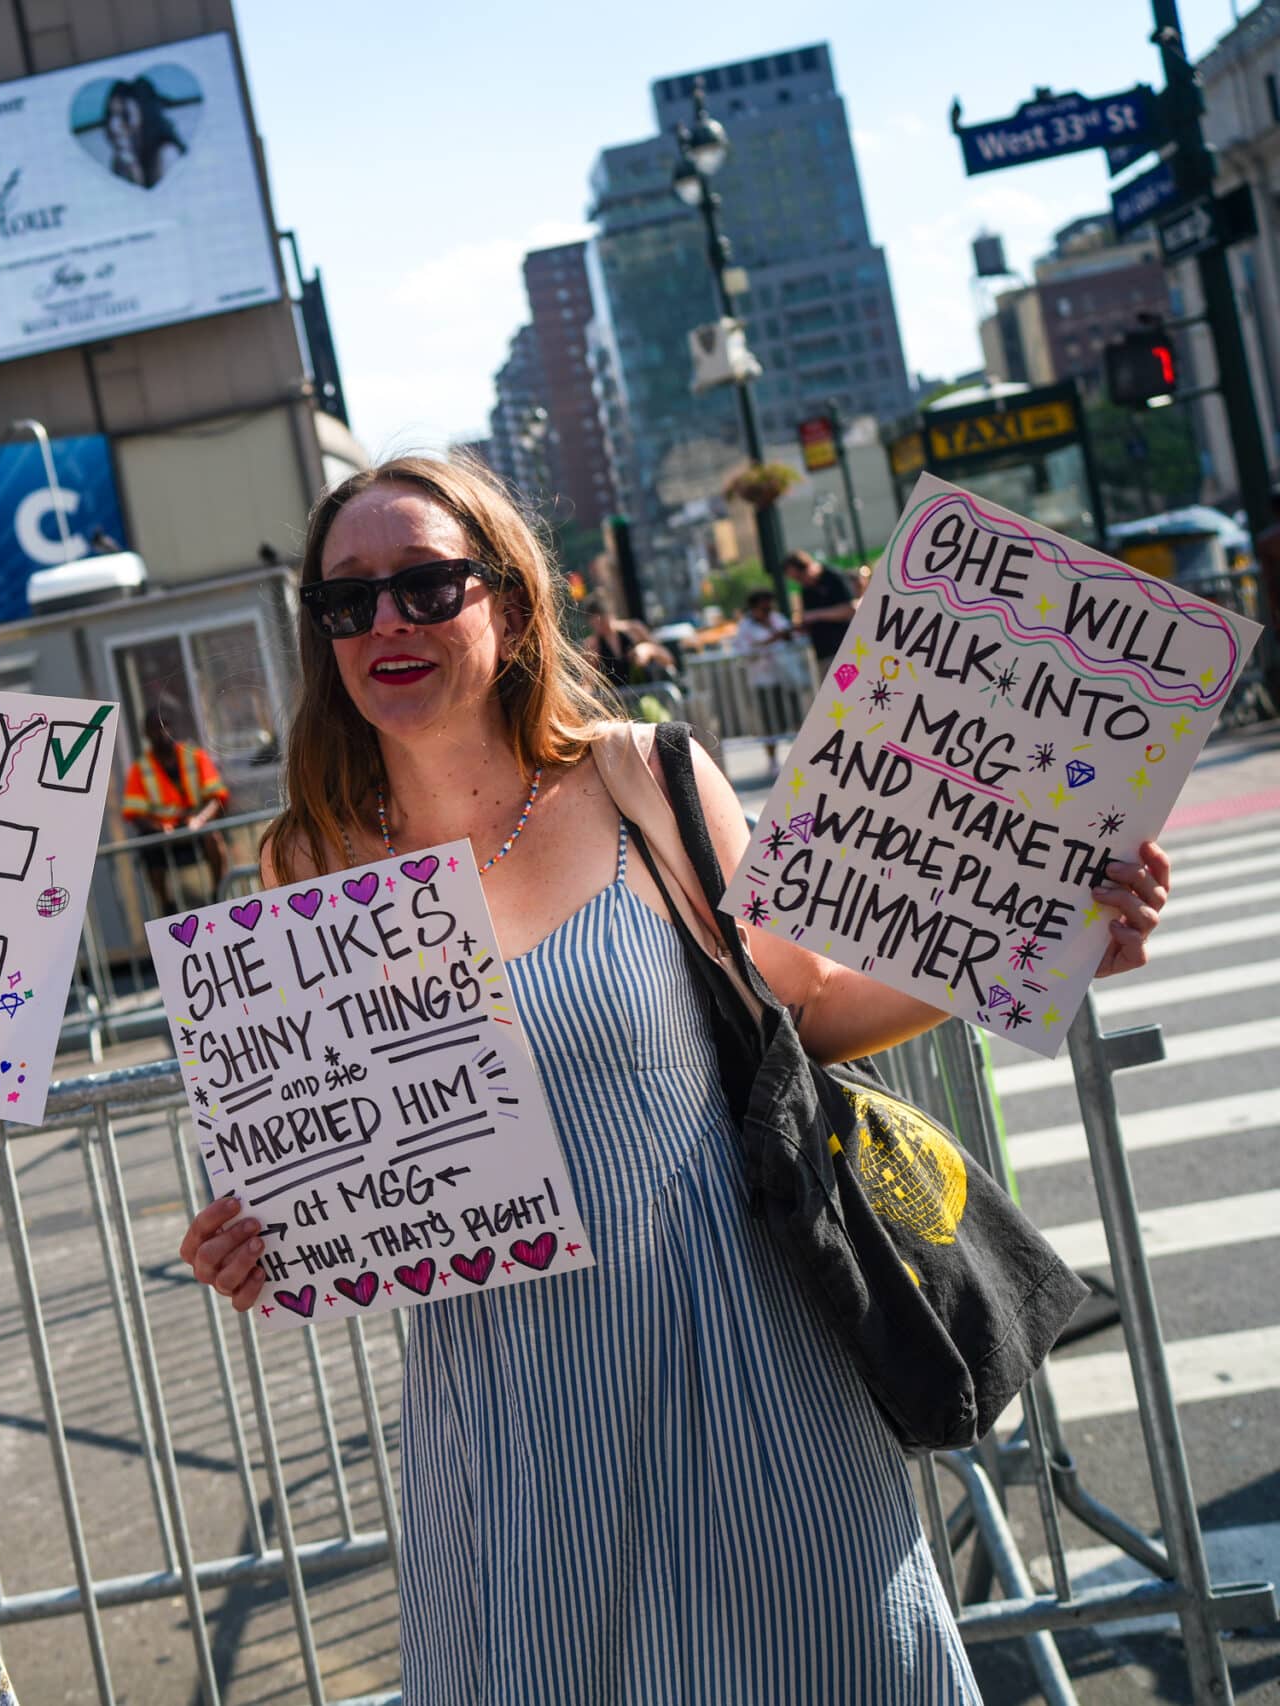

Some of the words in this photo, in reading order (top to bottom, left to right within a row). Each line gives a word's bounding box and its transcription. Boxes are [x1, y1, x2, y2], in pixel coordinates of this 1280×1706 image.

[974, 123, 1048, 161] West
[1105, 102, 1140, 134] St
[14, 486, 88, 567] C
[925, 512, 1035, 600] SHE
[1063, 581, 1187, 678] WILL
[874, 594, 1002, 687] WALK
[1020, 661, 1150, 741] INTO
[809, 729, 914, 798] AND
[928, 778, 1060, 870] MAKE
[900, 693, 1022, 788] MSG
[771, 848, 1003, 1009] SHIMMER
[812, 793, 956, 881] WHOLE
[949, 853, 1077, 942] PLACE
[180, 936, 274, 1022] SHE
[284, 882, 458, 992] LIKES
[199, 1009, 313, 1090] SHINY
[326, 958, 483, 1040] THINGS
[215, 1095, 383, 1174] MARRIED
[391, 1064, 478, 1127] HIM
[293, 1189, 329, 1228] at
[337, 1164, 437, 1213] MSG
[360, 1209, 456, 1257] THAT'S
[459, 1176, 566, 1243] RIGHT!
